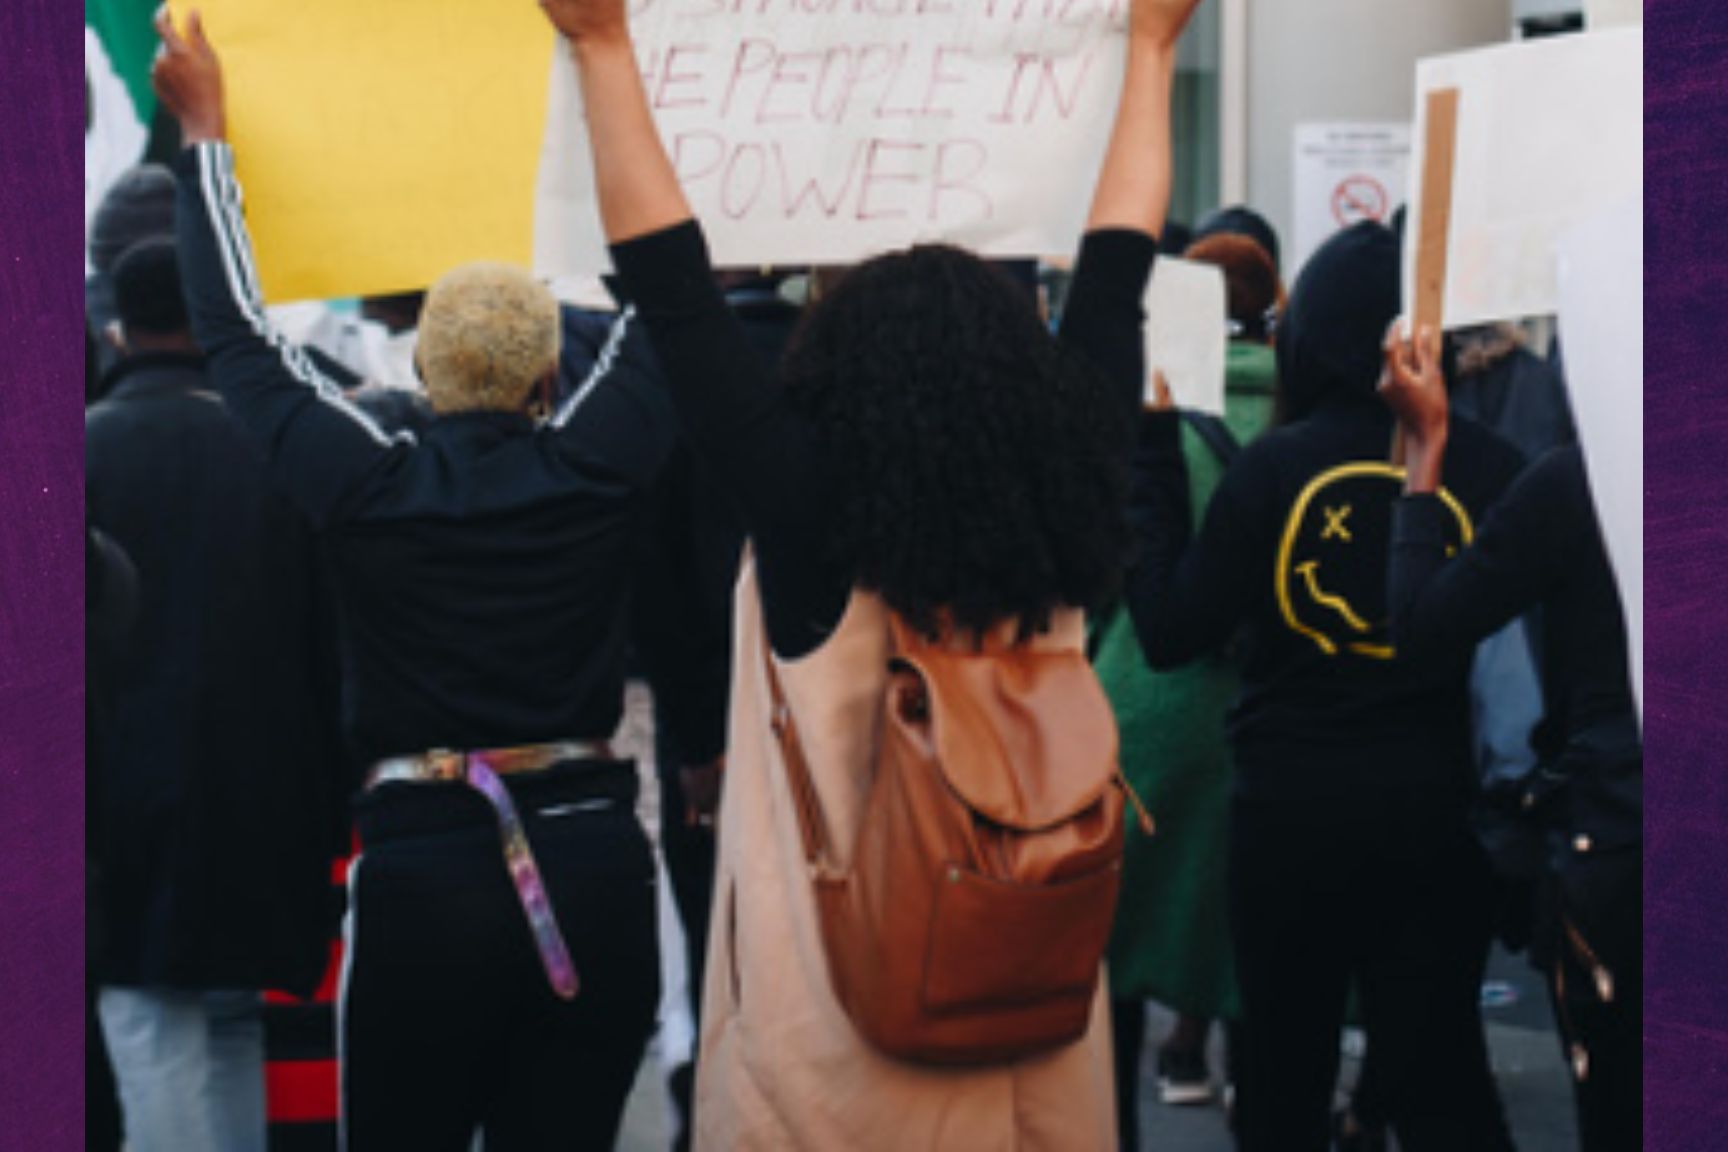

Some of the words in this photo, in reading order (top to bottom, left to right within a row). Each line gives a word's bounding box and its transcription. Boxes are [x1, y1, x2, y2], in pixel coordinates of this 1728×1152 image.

[718, 37, 972, 124] PEOPLE
[987, 51, 1095, 123] IN
[674, 131, 995, 223] POWER
